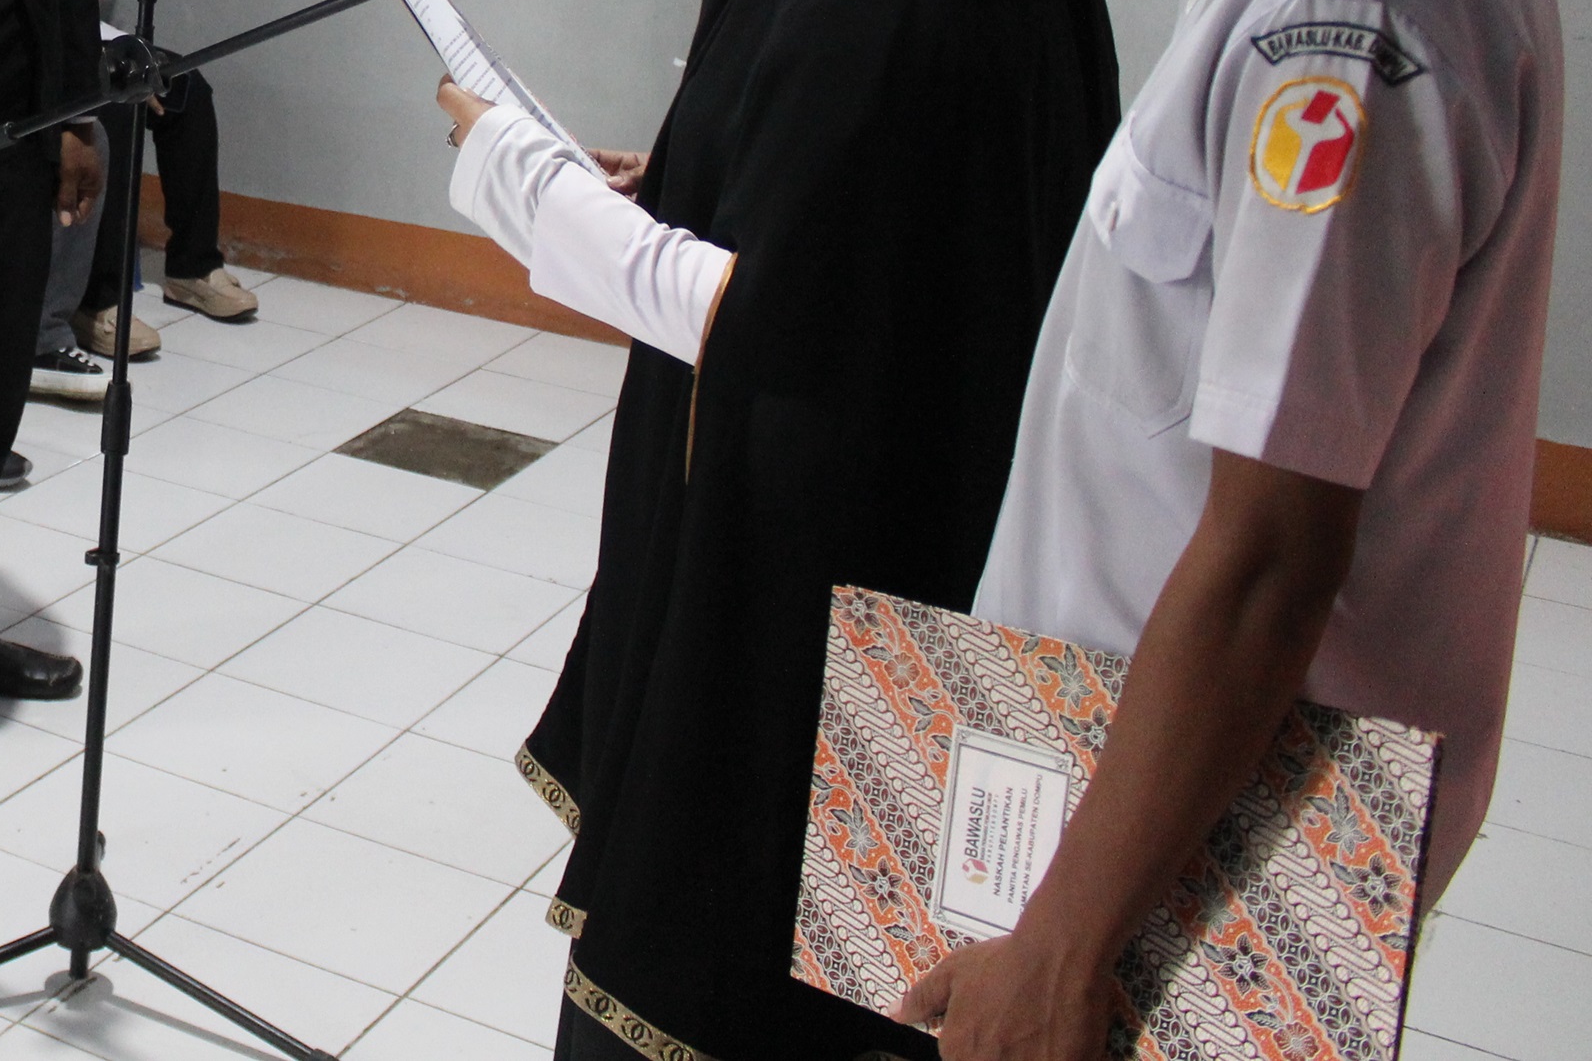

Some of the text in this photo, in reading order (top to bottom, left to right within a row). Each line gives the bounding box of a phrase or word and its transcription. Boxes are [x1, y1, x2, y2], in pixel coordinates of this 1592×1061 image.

[964, 787, 986, 858] BAWASLU
[1035, 774, 1043, 806] DOMPU
[993, 787, 1014, 896] NASKAH PELANTIKAN
[1008, 788, 1028, 904] PANITIA PENGAWAS PEMILU
